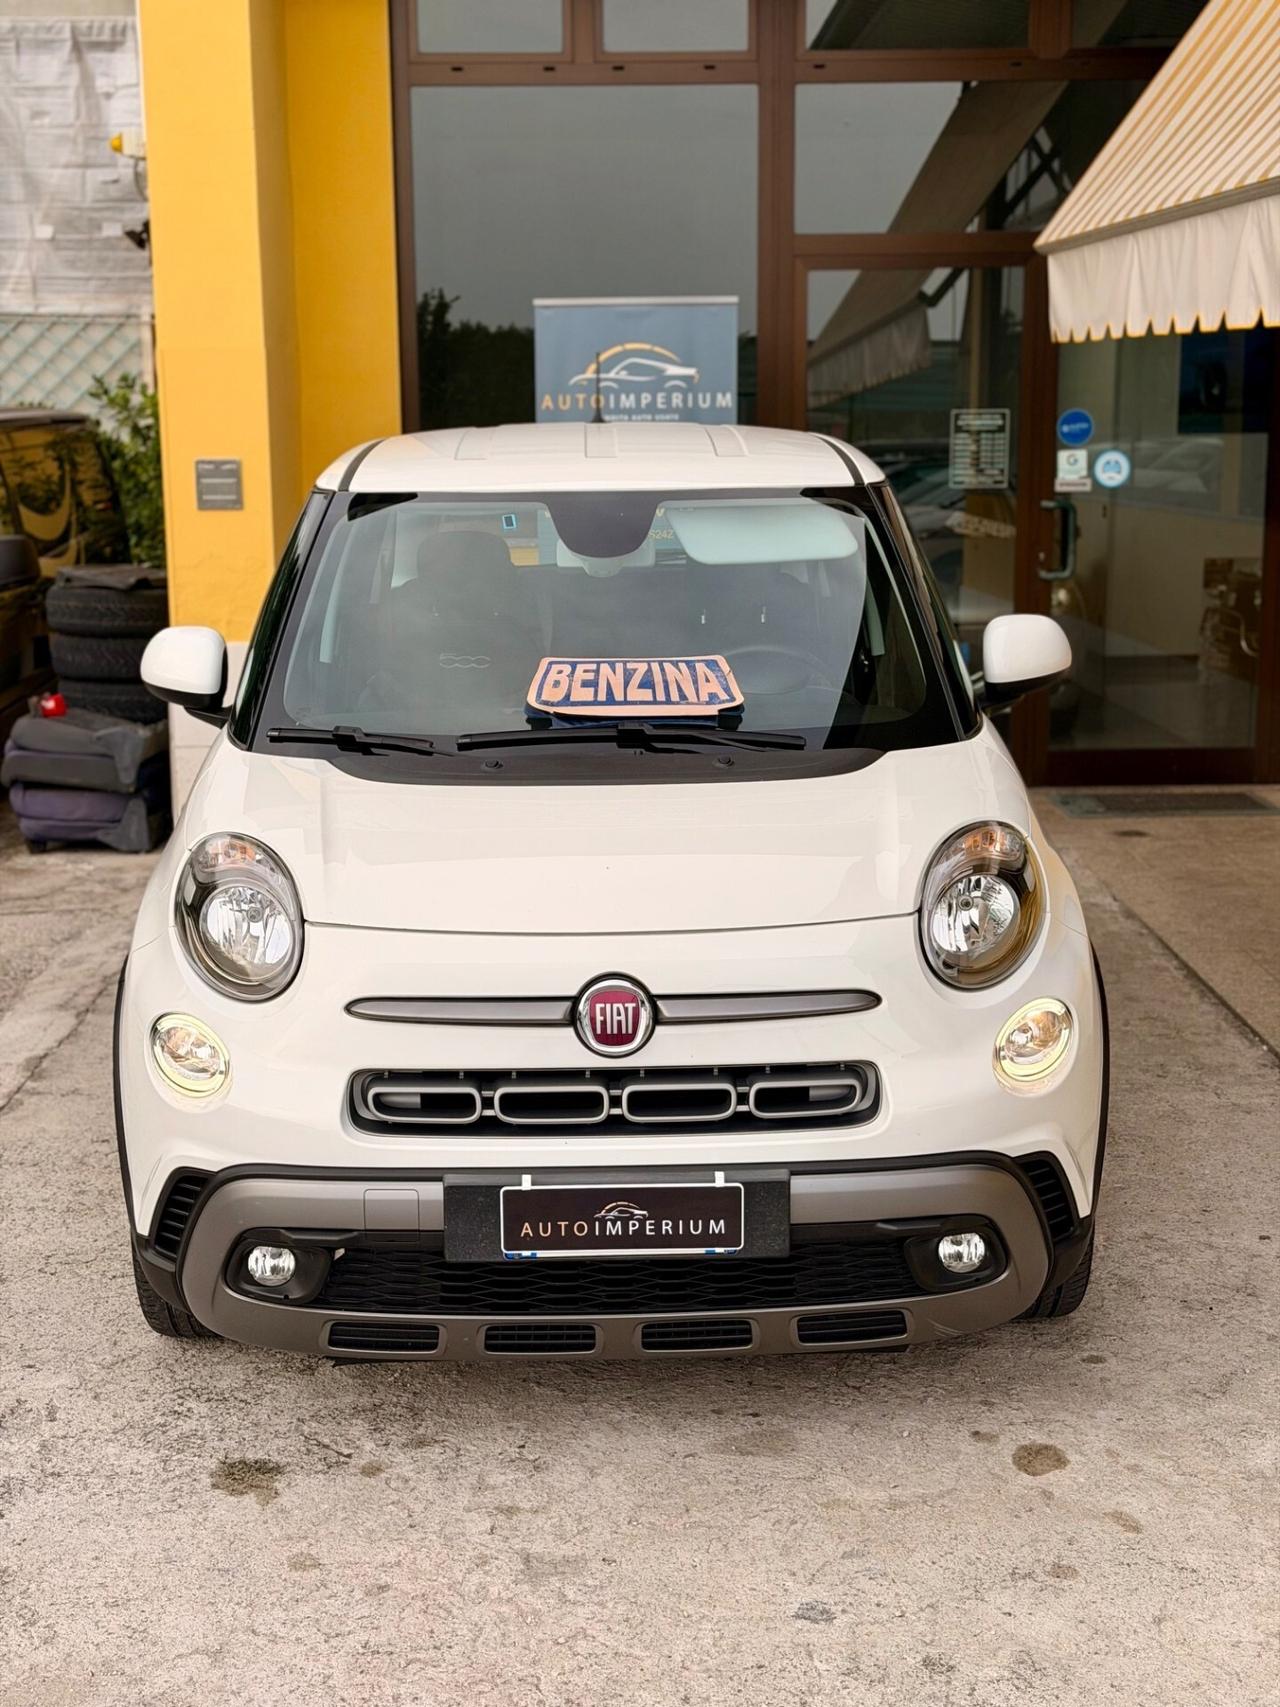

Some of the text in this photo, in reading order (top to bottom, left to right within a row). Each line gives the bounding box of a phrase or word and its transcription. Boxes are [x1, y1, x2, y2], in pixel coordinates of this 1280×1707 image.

[541, 391, 733, 410] AUTOIMPERIUM
[541, 661, 731, 703] BENZINA
[594, 1003, 637, 1035] FIAT
[520, 1219, 726, 1238] AUTOIMPERIUM
